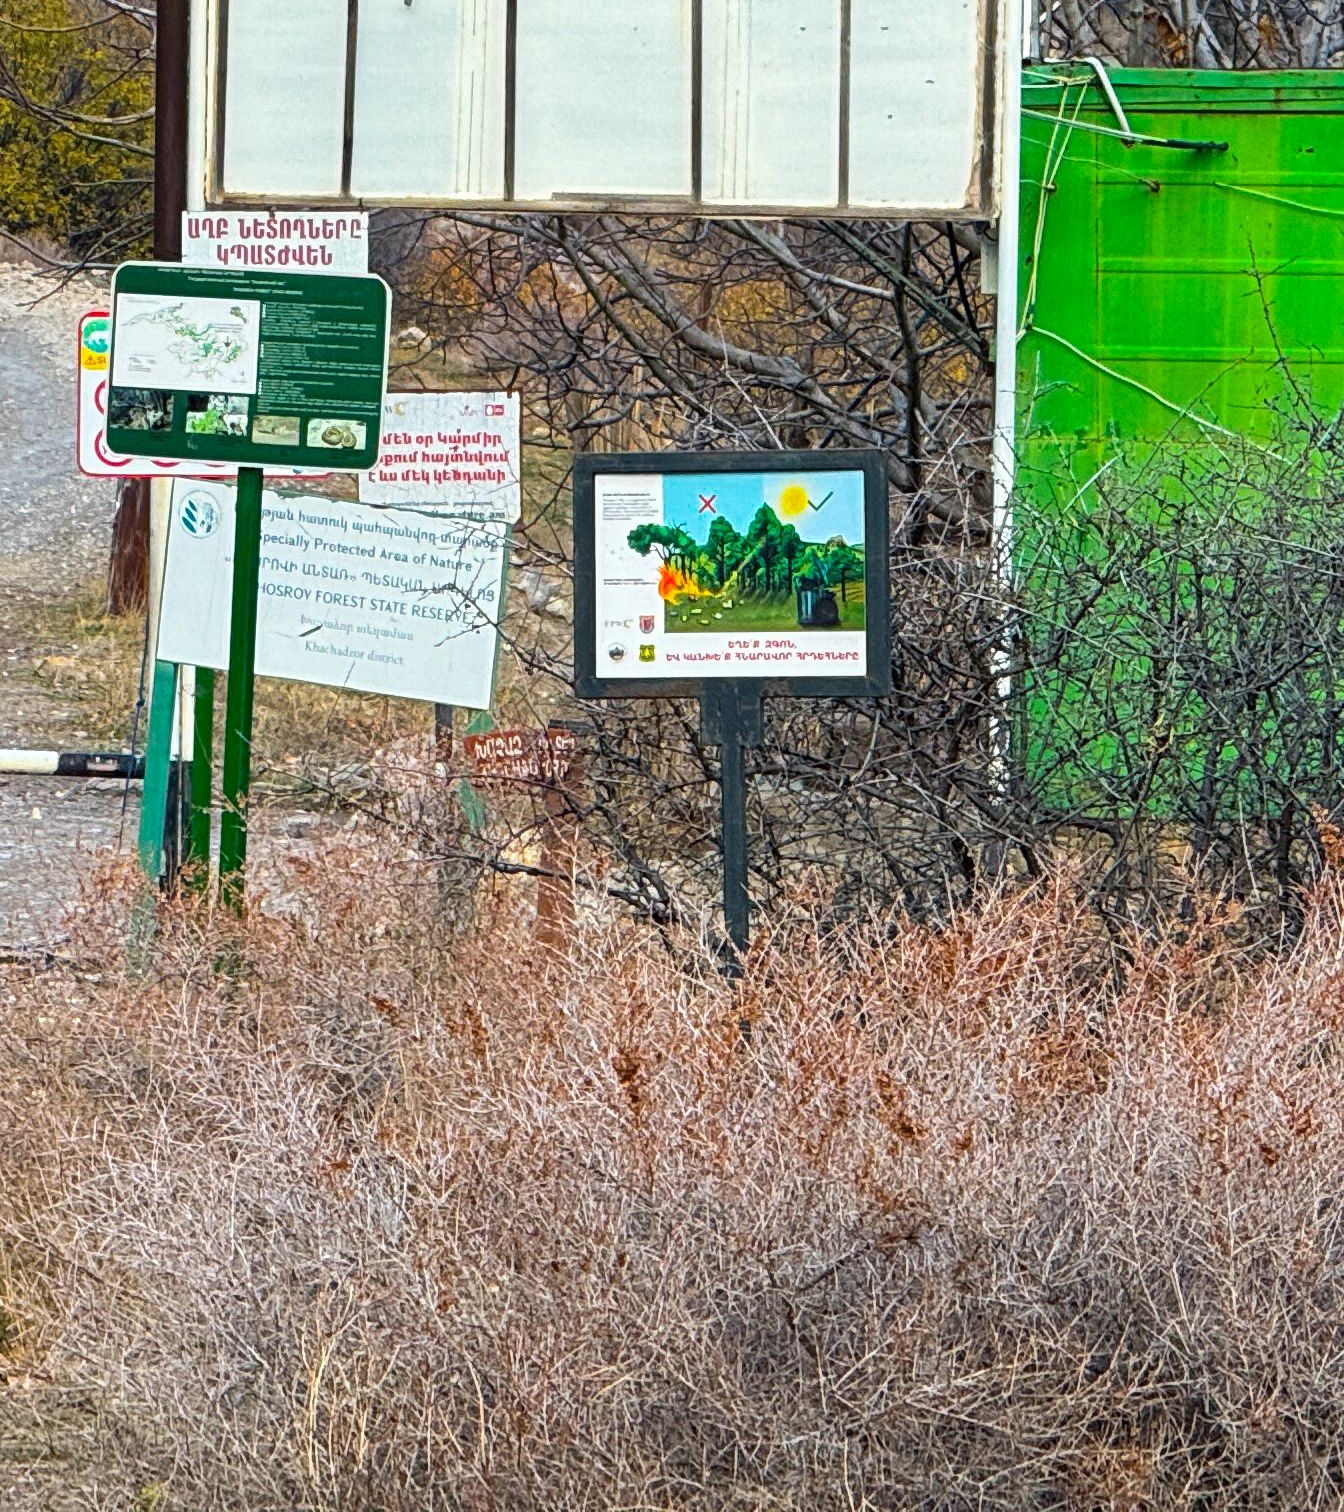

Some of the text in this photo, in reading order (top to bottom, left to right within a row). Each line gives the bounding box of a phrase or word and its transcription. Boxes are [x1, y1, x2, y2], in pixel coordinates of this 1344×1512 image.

[187, 217, 362, 240] ԱՂԲ ՆԵՏՈՂՆԵՐԸ
[216, 244, 333, 266] ԿՊԱՏԺՎԵՆ
[382, 432, 412, 445] մեն
[261, 532, 472, 572] pecially Protected Area of Nature
[261, 582, 475, 625] HOSROV FOREST STATE RESERVE
